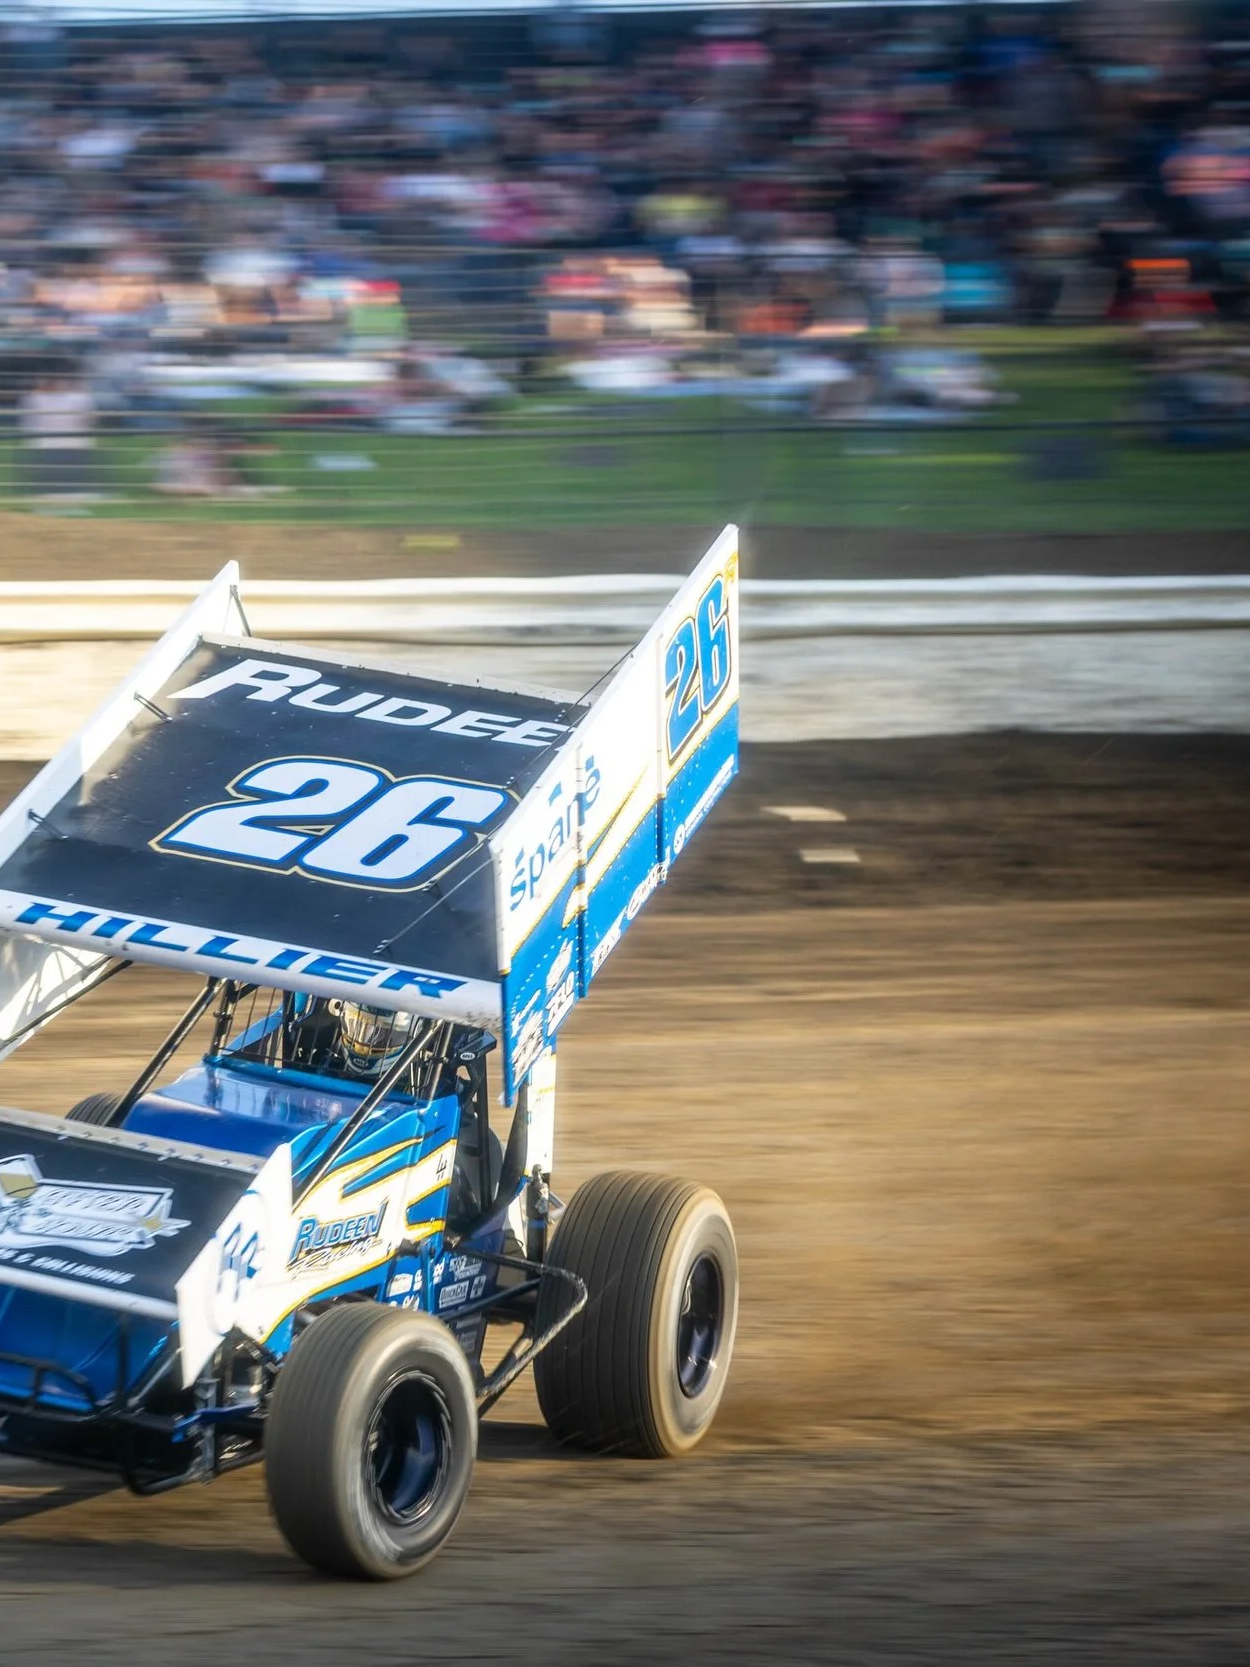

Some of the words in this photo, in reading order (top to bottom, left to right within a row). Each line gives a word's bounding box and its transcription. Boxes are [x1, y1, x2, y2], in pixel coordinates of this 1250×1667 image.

[166, 658, 577, 750] RUDEE
[664, 576, 731, 761] 26
[155, 756, 513, 886] 26
[15, 901, 469, 999] HILLIER
[288, 1199, 388, 1263] RUDEEN
